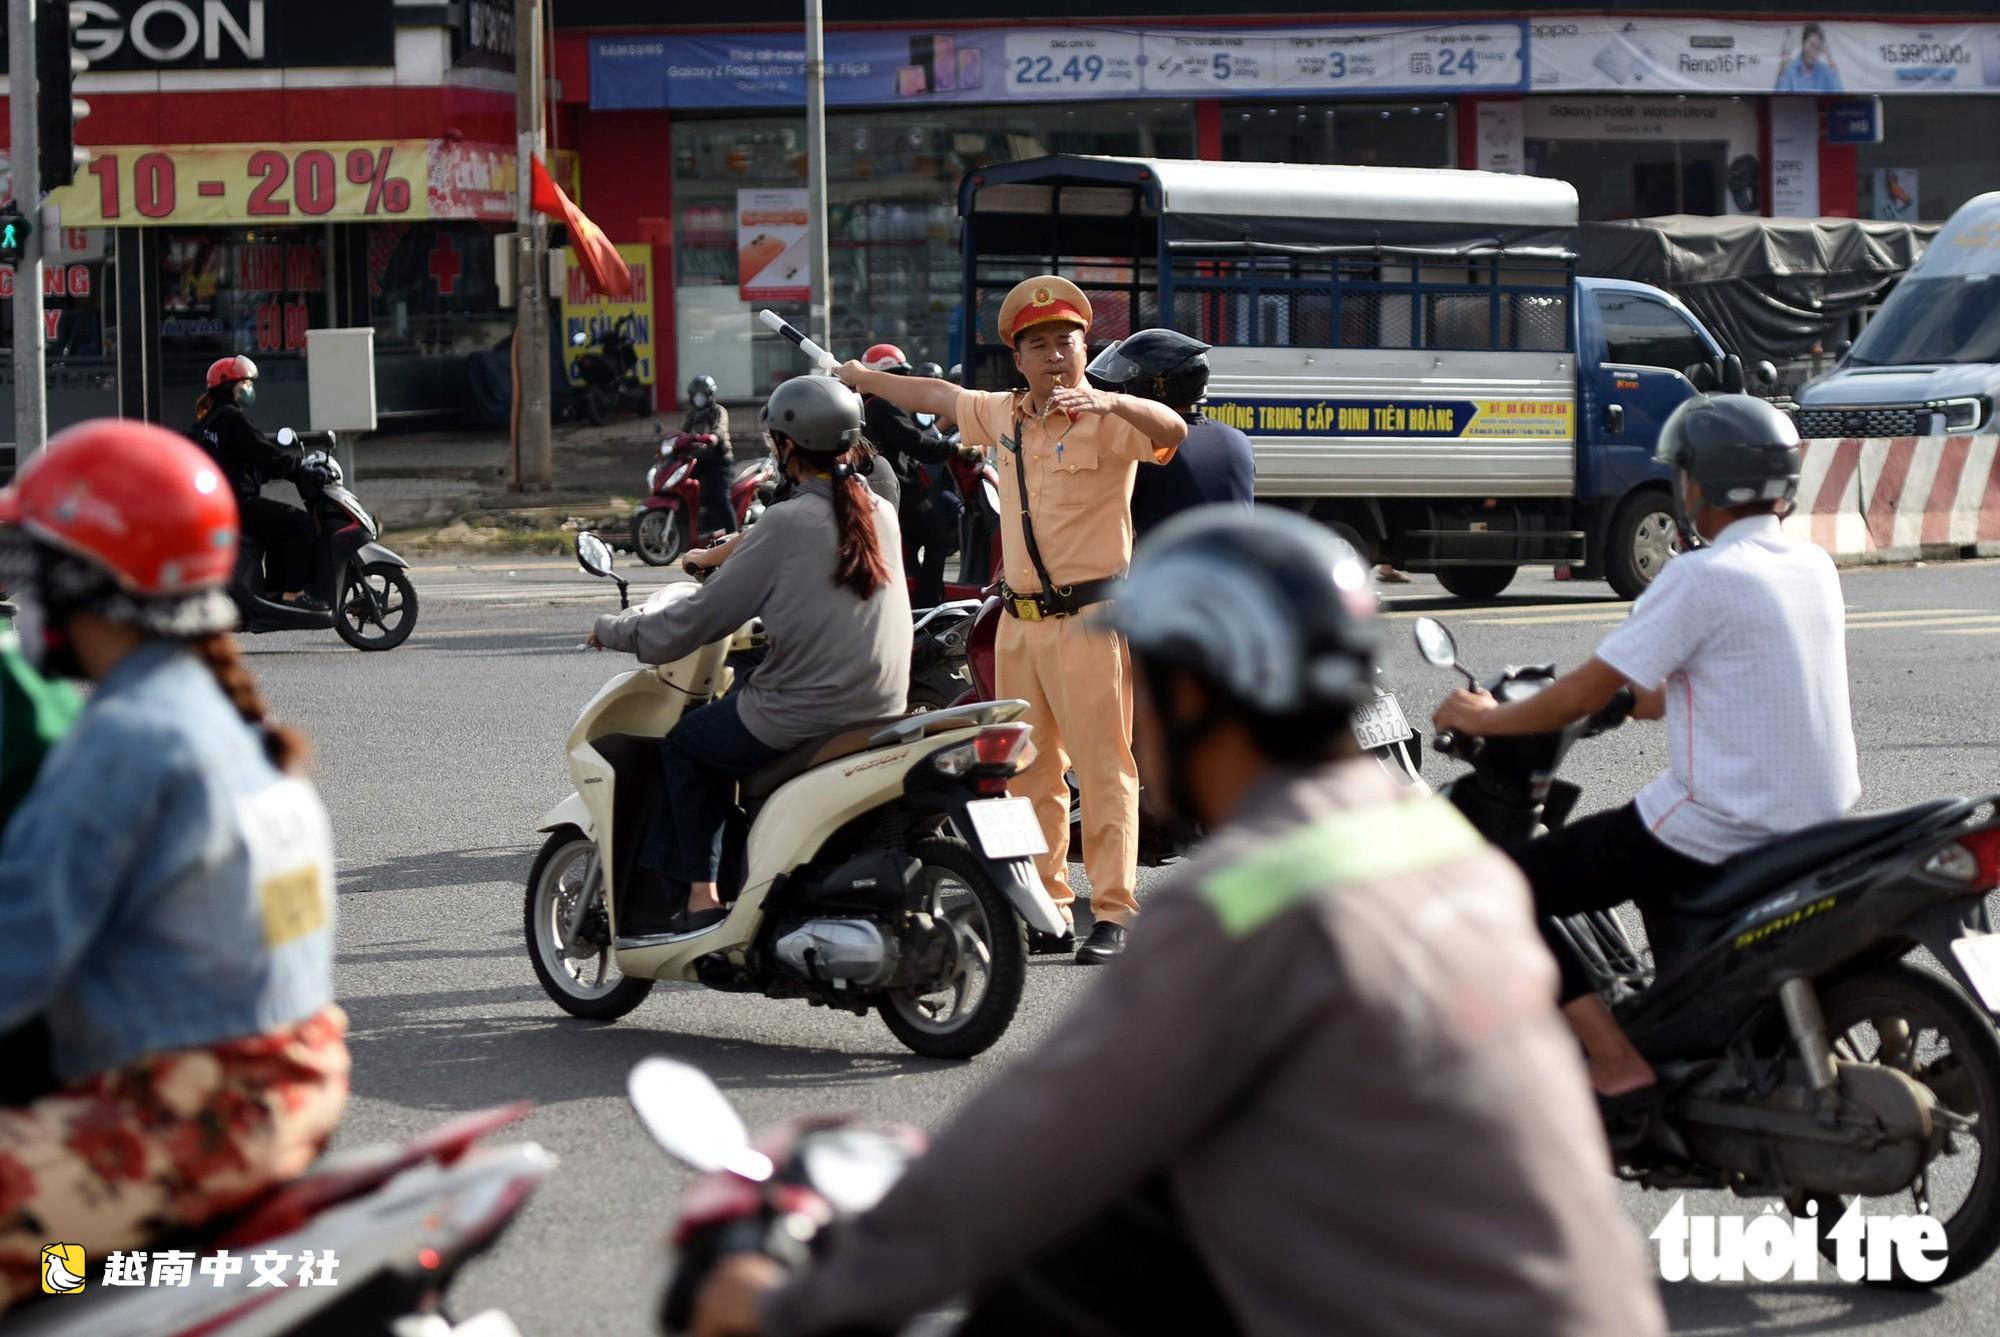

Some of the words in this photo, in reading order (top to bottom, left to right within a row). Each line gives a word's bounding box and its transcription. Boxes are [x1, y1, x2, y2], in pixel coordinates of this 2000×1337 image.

[600, 44, 664, 56] SAMSUNG
[1437, 48, 1479, 75] 24
[667, 65, 714, 78] Galaxy
[1016, 55, 1104, 82] 22.49
[1213, 53, 1231, 80] 5
[1328, 52, 1346, 78] 3
[88, 152, 176, 218] 10
[247, 147, 410, 216] 20%
[1259, 406, 1302, 430] TRUNG
[1305, 401, 1335, 431] CẤP
[1374, 404, 1406, 432] TIÊN
[1409, 404, 1455, 432] HOÀNG
